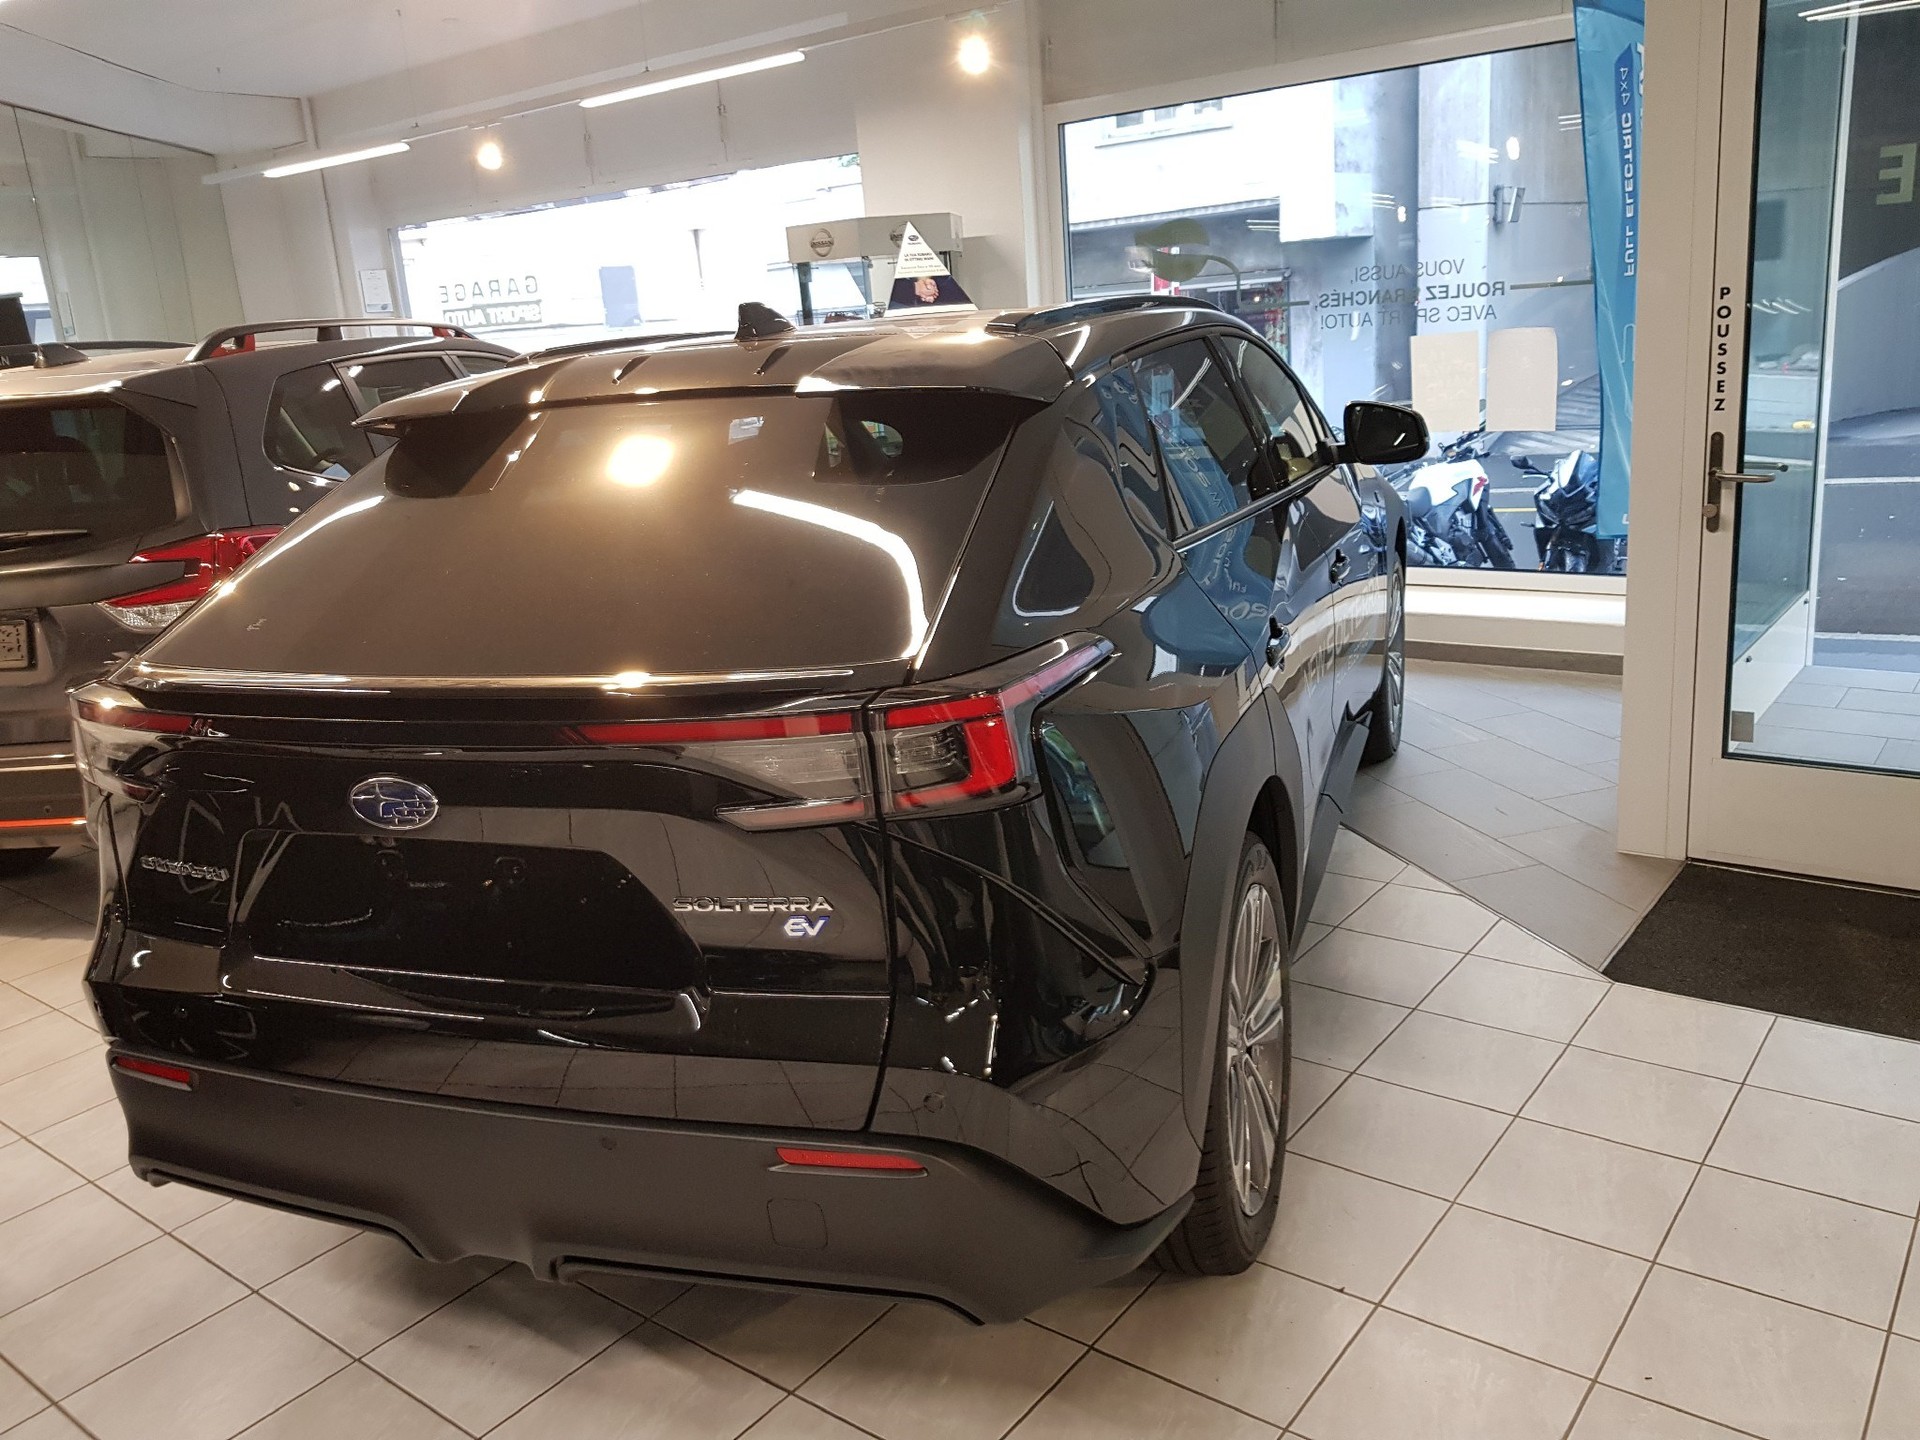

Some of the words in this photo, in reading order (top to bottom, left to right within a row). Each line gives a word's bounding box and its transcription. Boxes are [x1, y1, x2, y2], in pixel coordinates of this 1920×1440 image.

[1713, 286, 1732, 412] POUSSEZ
[672, 896, 834, 912] SOLTERRA
[783, 914, 831, 937] EV
